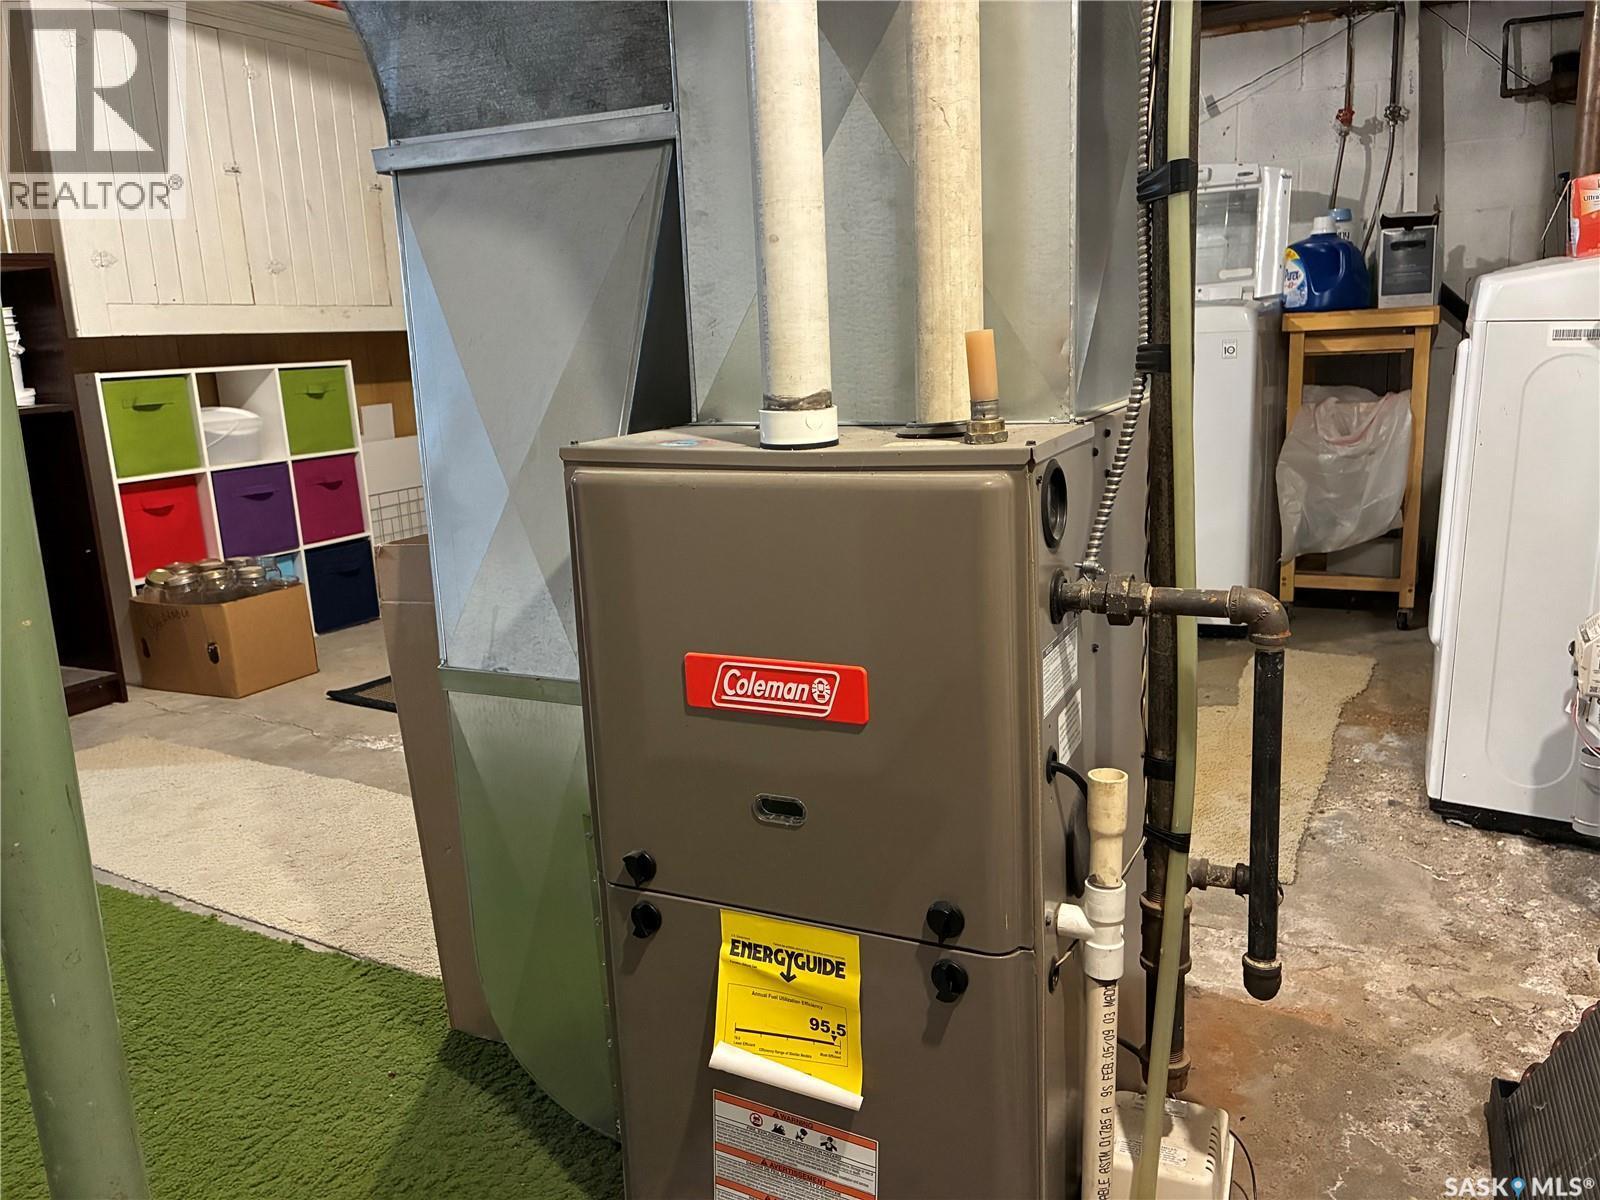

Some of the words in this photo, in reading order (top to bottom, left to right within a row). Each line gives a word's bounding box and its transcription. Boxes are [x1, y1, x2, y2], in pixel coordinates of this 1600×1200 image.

[723, 668, 810, 702] Coleman
[729, 938, 846, 981] ENERGYGUIDE
[751, 990, 768, 998] Annual
[778, 995, 800, 1004] Utilization
[801, 1000, 823, 1010] Efficiency
[809, 1017, 847, 1037] 95.5
[780, 1112, 813, 1129] WARNING
[1098, 1151, 1111, 1174] ASTM
